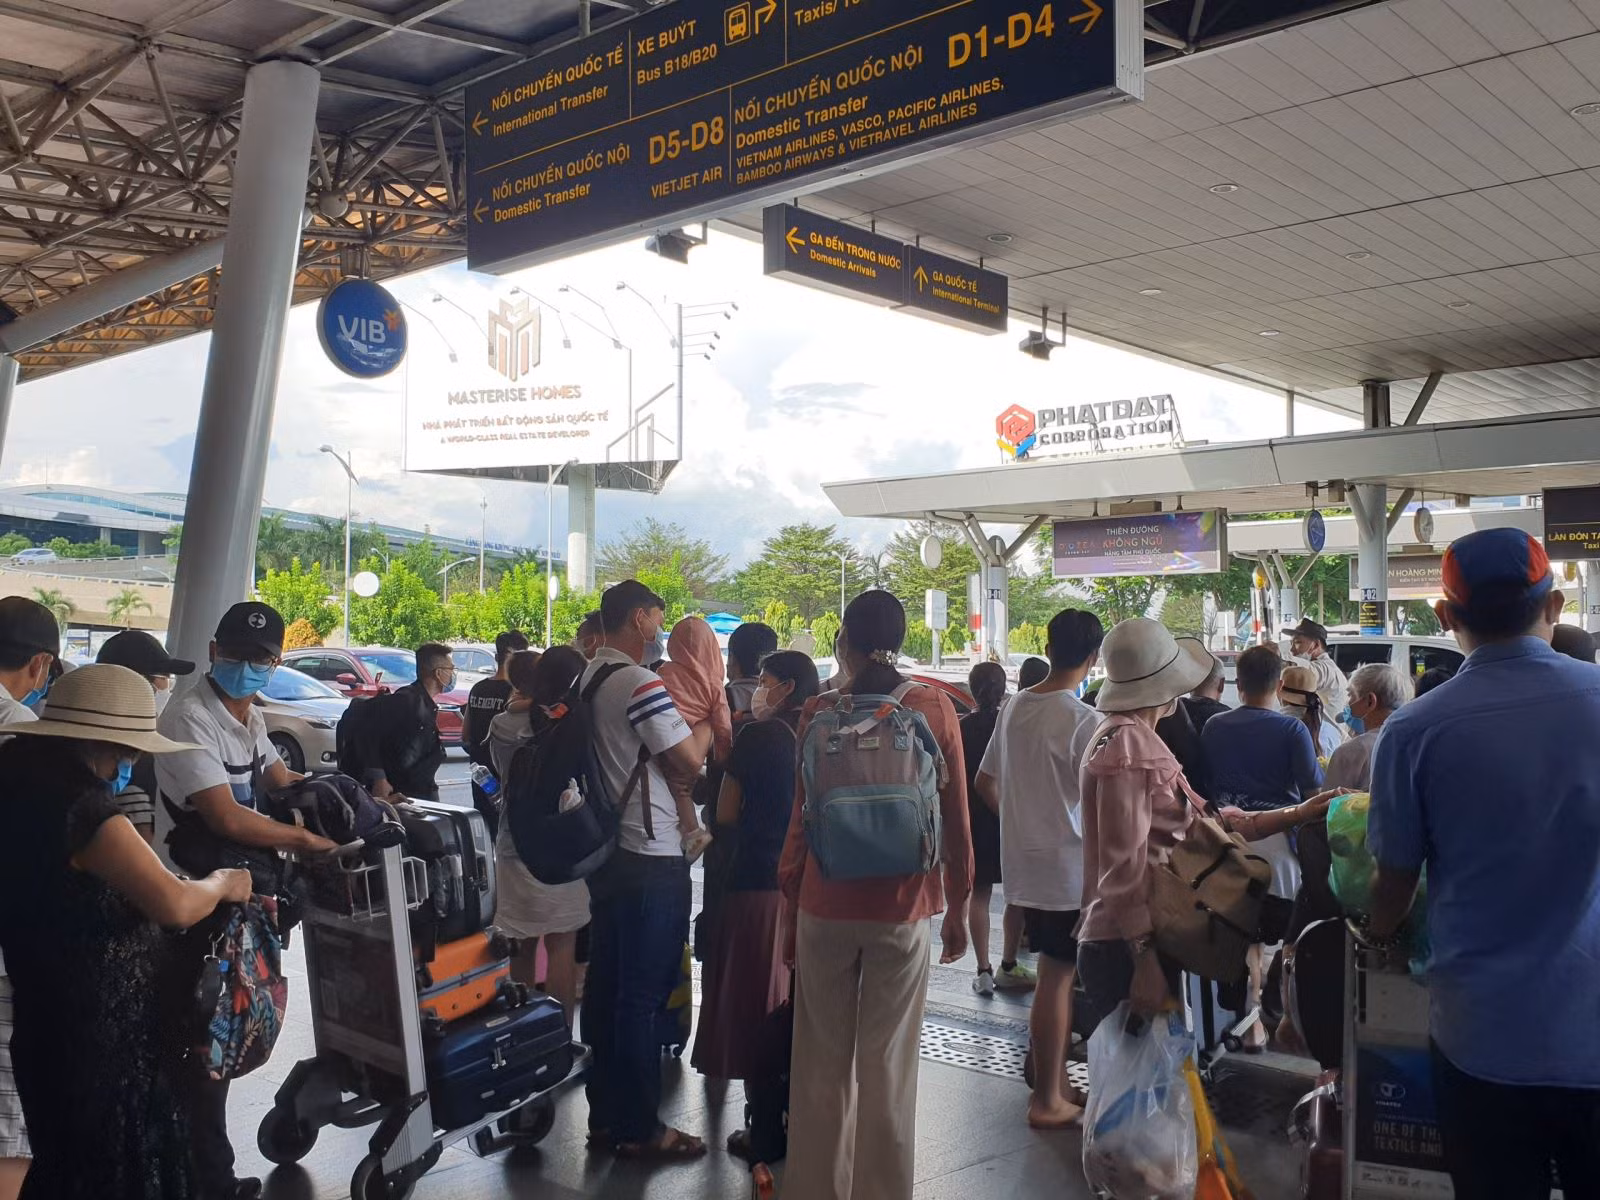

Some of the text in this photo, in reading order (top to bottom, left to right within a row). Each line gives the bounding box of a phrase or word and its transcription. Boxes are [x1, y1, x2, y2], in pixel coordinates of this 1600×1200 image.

[637, 20, 696, 56] XE BUÝT
[949, 4, 1054, 68] D1-D4
[492, 88, 511, 112] NỐI
[566, 55, 602, 82] QUỐC
[607, 43, 624, 66] TẾ
[637, 44, 717, 84] Bus B18/B20
[735, 97, 760, 124] NỐI
[836, 56, 885, 90] QUỐC
[891, 45, 922, 72] NỘI
[493, 86, 608, 136] International Transfer
[736, 96, 868, 149] Domestic Transfer
[737, 78, 1004, 168] VIETNAM AIRLINES, VASCO, PACIFIC AIRLINES,
[650, 117, 724, 164] D5-D8
[737, 103, 977, 184] BAMBOO AIRWAYS & VIETRAVEL AIRLINES
[493, 178, 512, 201] NỐI
[567, 150, 603, 176] QUỐC
[608, 143, 630, 164] NỘI
[652, 167, 722, 198] VIETJET AIR
[494, 183, 590, 222] Domestic Transfer
[810, 232, 901, 269] GA ĐẾN TRONG NƯỚC
[810, 250, 876, 278] Domestic Arrivals
[933, 271, 977, 292] GA QUỐC TẾ
[932, 287, 1000, 314] International Terminal
[338, 315, 386, 344] VIB
[448, 385, 582, 406] MASTERISE HOMES
[1038, 394, 1171, 429] PHATDAT
[566, 411, 596, 425] QUỐC
[598, 409, 609, 422] TẾ
[1039, 420, 1172, 446] CORPORATION
[448, 434, 498, 443] WORLD-CLASS
[500, 432, 518, 441] REAL
[520, 431, 546, 440] ESTATE
[548, 429, 590, 439] DEVELOPER
[1548, 532, 1566, 541] LÀN
[1569, 531, 1588, 540] ĐÓN
[1396, 568, 1425, 576] HOÀNG
[1374, 1121, 1396, 1136] ONE
[1402, 1124, 1416, 1137] OF
